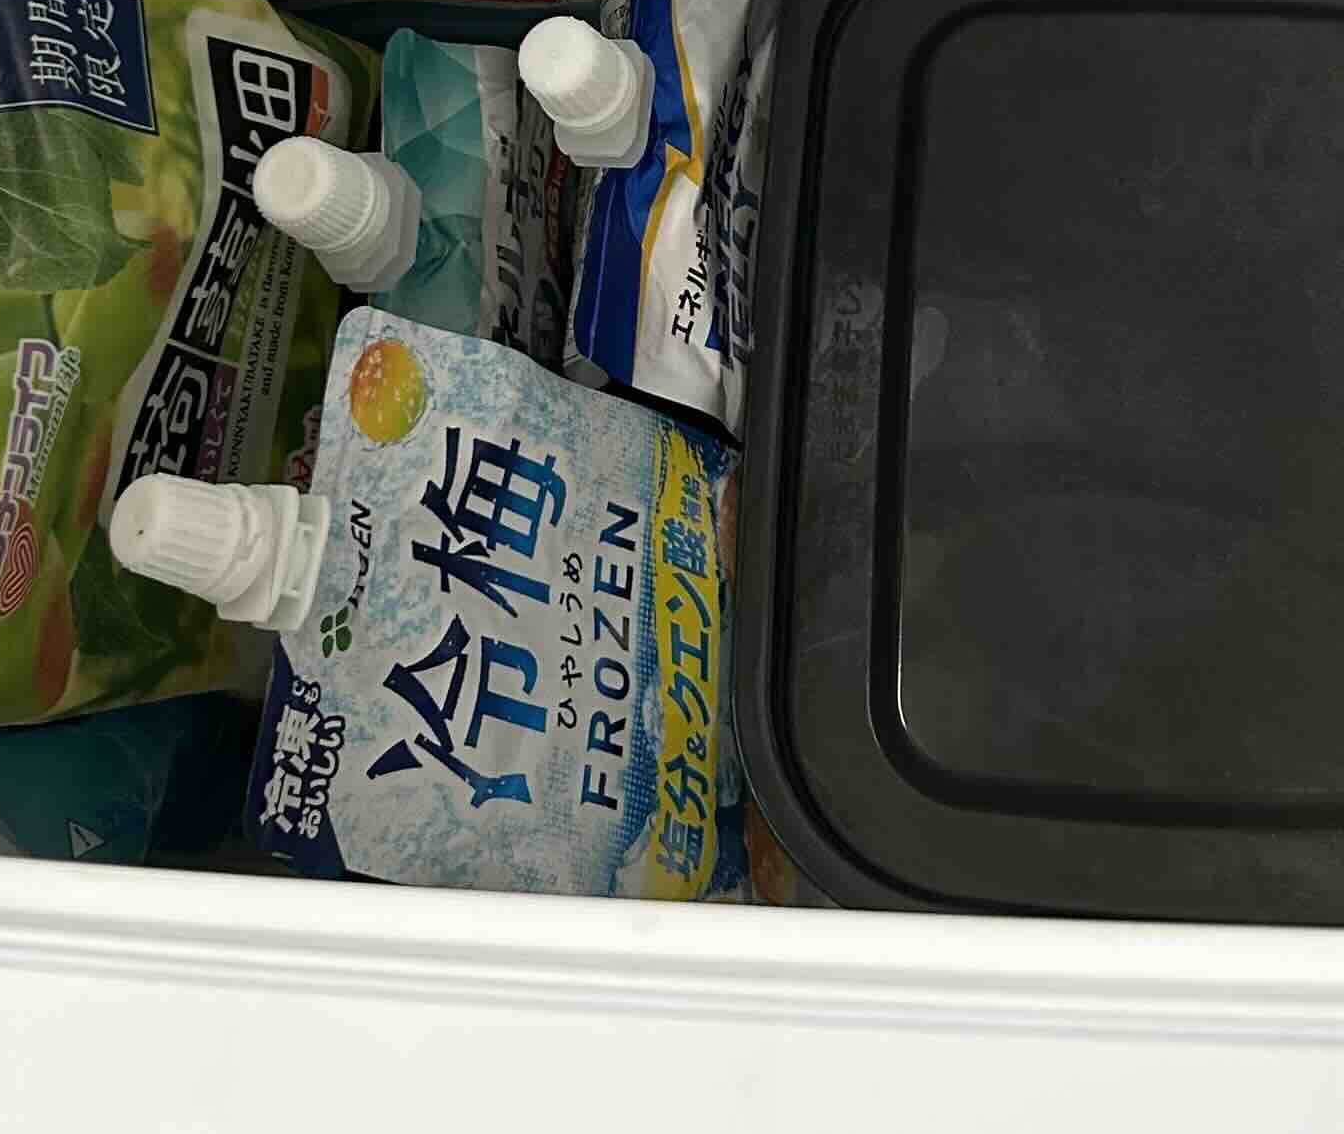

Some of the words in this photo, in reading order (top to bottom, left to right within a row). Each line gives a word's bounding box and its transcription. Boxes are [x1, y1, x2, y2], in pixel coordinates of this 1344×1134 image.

[366, 427, 570, 810] 冷梅
[558, 552, 585, 729] ひやしうめ
[580, 502, 640, 811] FROZEN
[298, 714, 347, 840] おいしい
